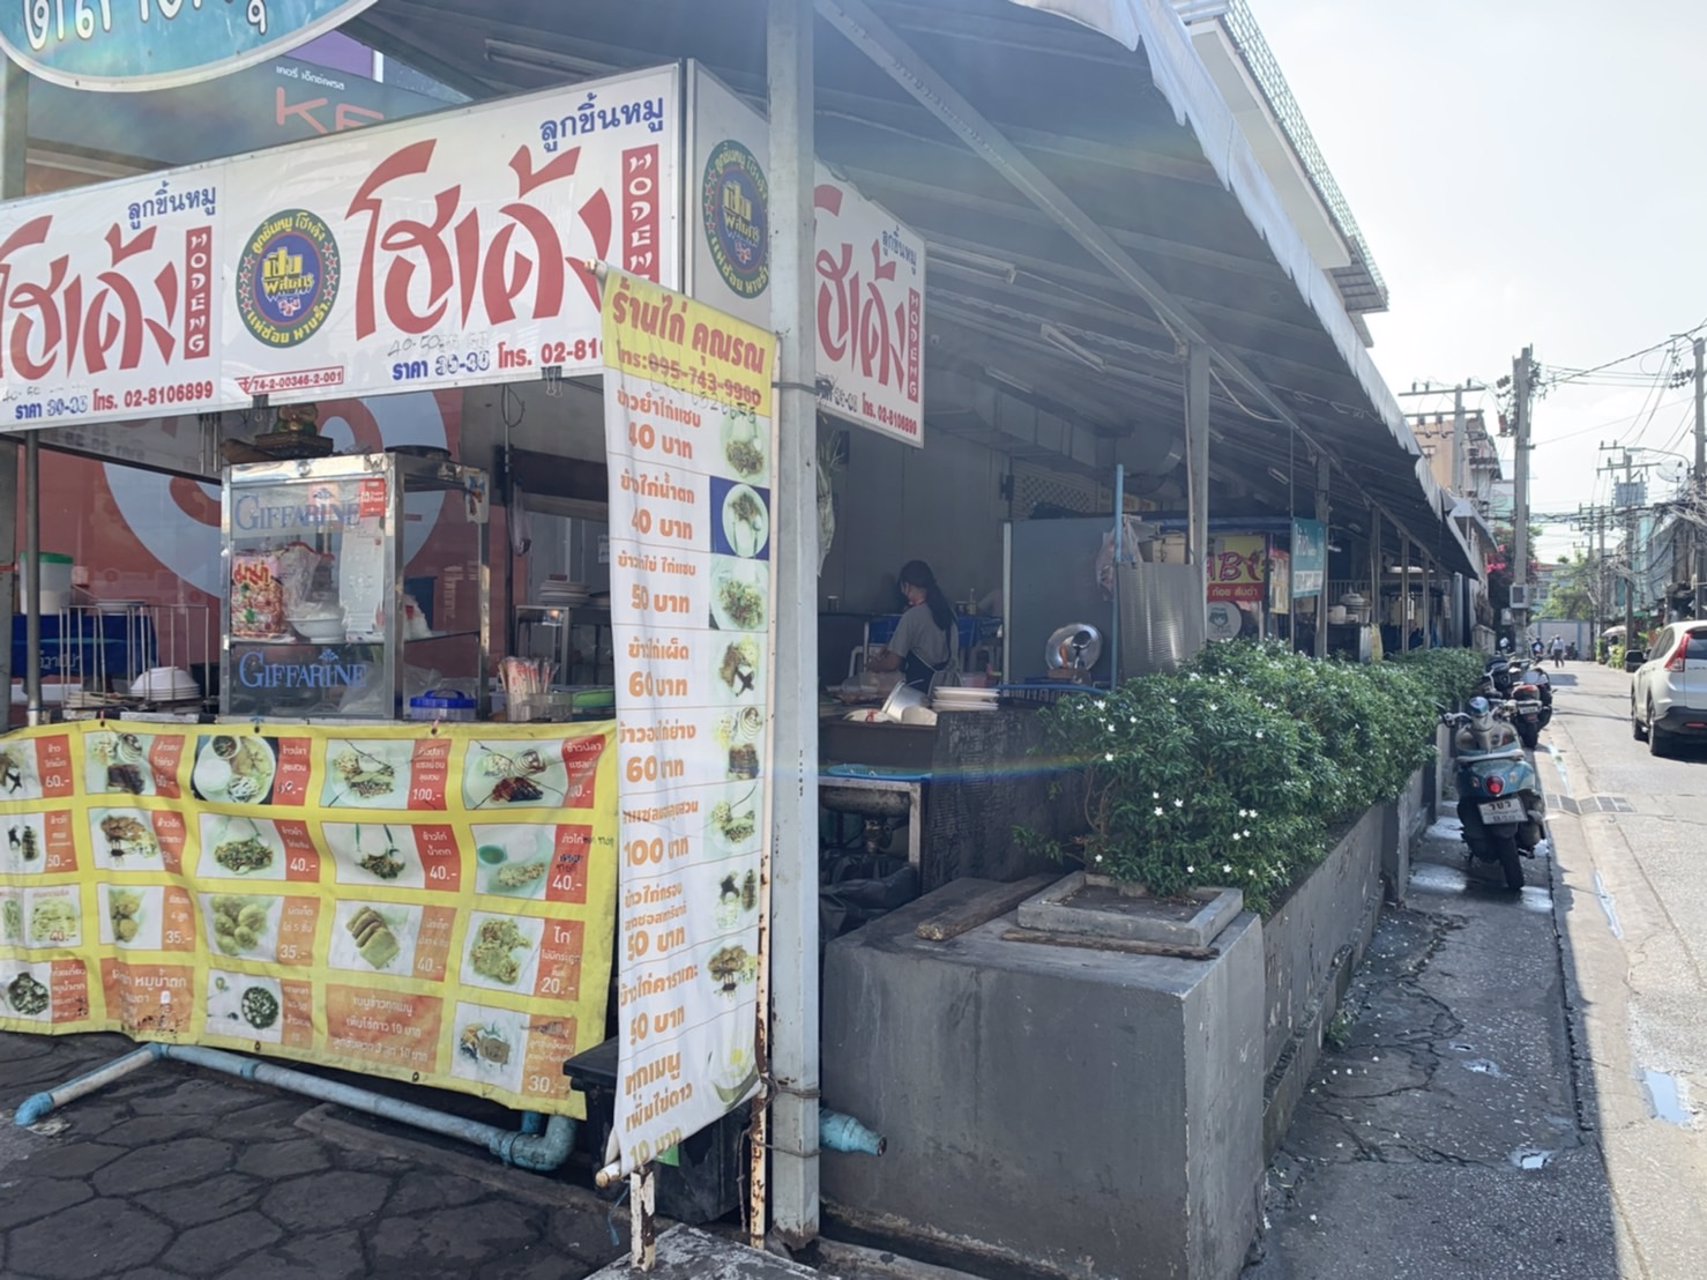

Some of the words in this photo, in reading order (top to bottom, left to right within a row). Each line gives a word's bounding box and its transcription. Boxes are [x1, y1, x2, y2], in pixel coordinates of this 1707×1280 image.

[540, 93, 664, 152] ลูกชิ้นหมู
[128, 180, 216, 230] ลูกชิ้นหมู
[628, 154, 653, 277] HODEN
[612, 275, 688, 346] ร้านไก่
[392, 359, 429, 381] ราคา
[497, 341, 533, 369] โทร.
[540, 337, 603, 363] 02-81
[15, 401, 43, 420] ราคา
[93, 387, 118, 413] โทร.
[124, 380, 213, 409] 02-8106899
[661, 434, 693, 460] บาท
[235, 495, 361, 531] GIFFARINE
[659, 517, 693, 541] บาท
[631, 584, 650, 610] 50
[653, 593, 690, 614] บาท
[239, 651, 367, 689] GIFFARINE
[628, 671, 655, 697] 60
[656, 676, 689, 697] บาท
[626, 755, 658, 783] 60
[412, 787, 443, 801] 100.-
[289, 857, 317, 872] 40.-
[624, 837, 664, 867] 100
[429, 865, 457, 880] 40.-
[552, 874, 583, 892] 40.-
[165, 930, 193, 944] 35.-
[553, 926, 570, 944] ไก่
[627, 929, 650, 961] 50
[656, 926, 687, 953] บาท
[279, 944, 308, 959] 35.-
[417, 956, 443, 973] 40.-
[541, 977, 576, 995] 20.-
[654, 1006, 686, 1034] บาท
[528, 1076, 567, 1094] 30.-
